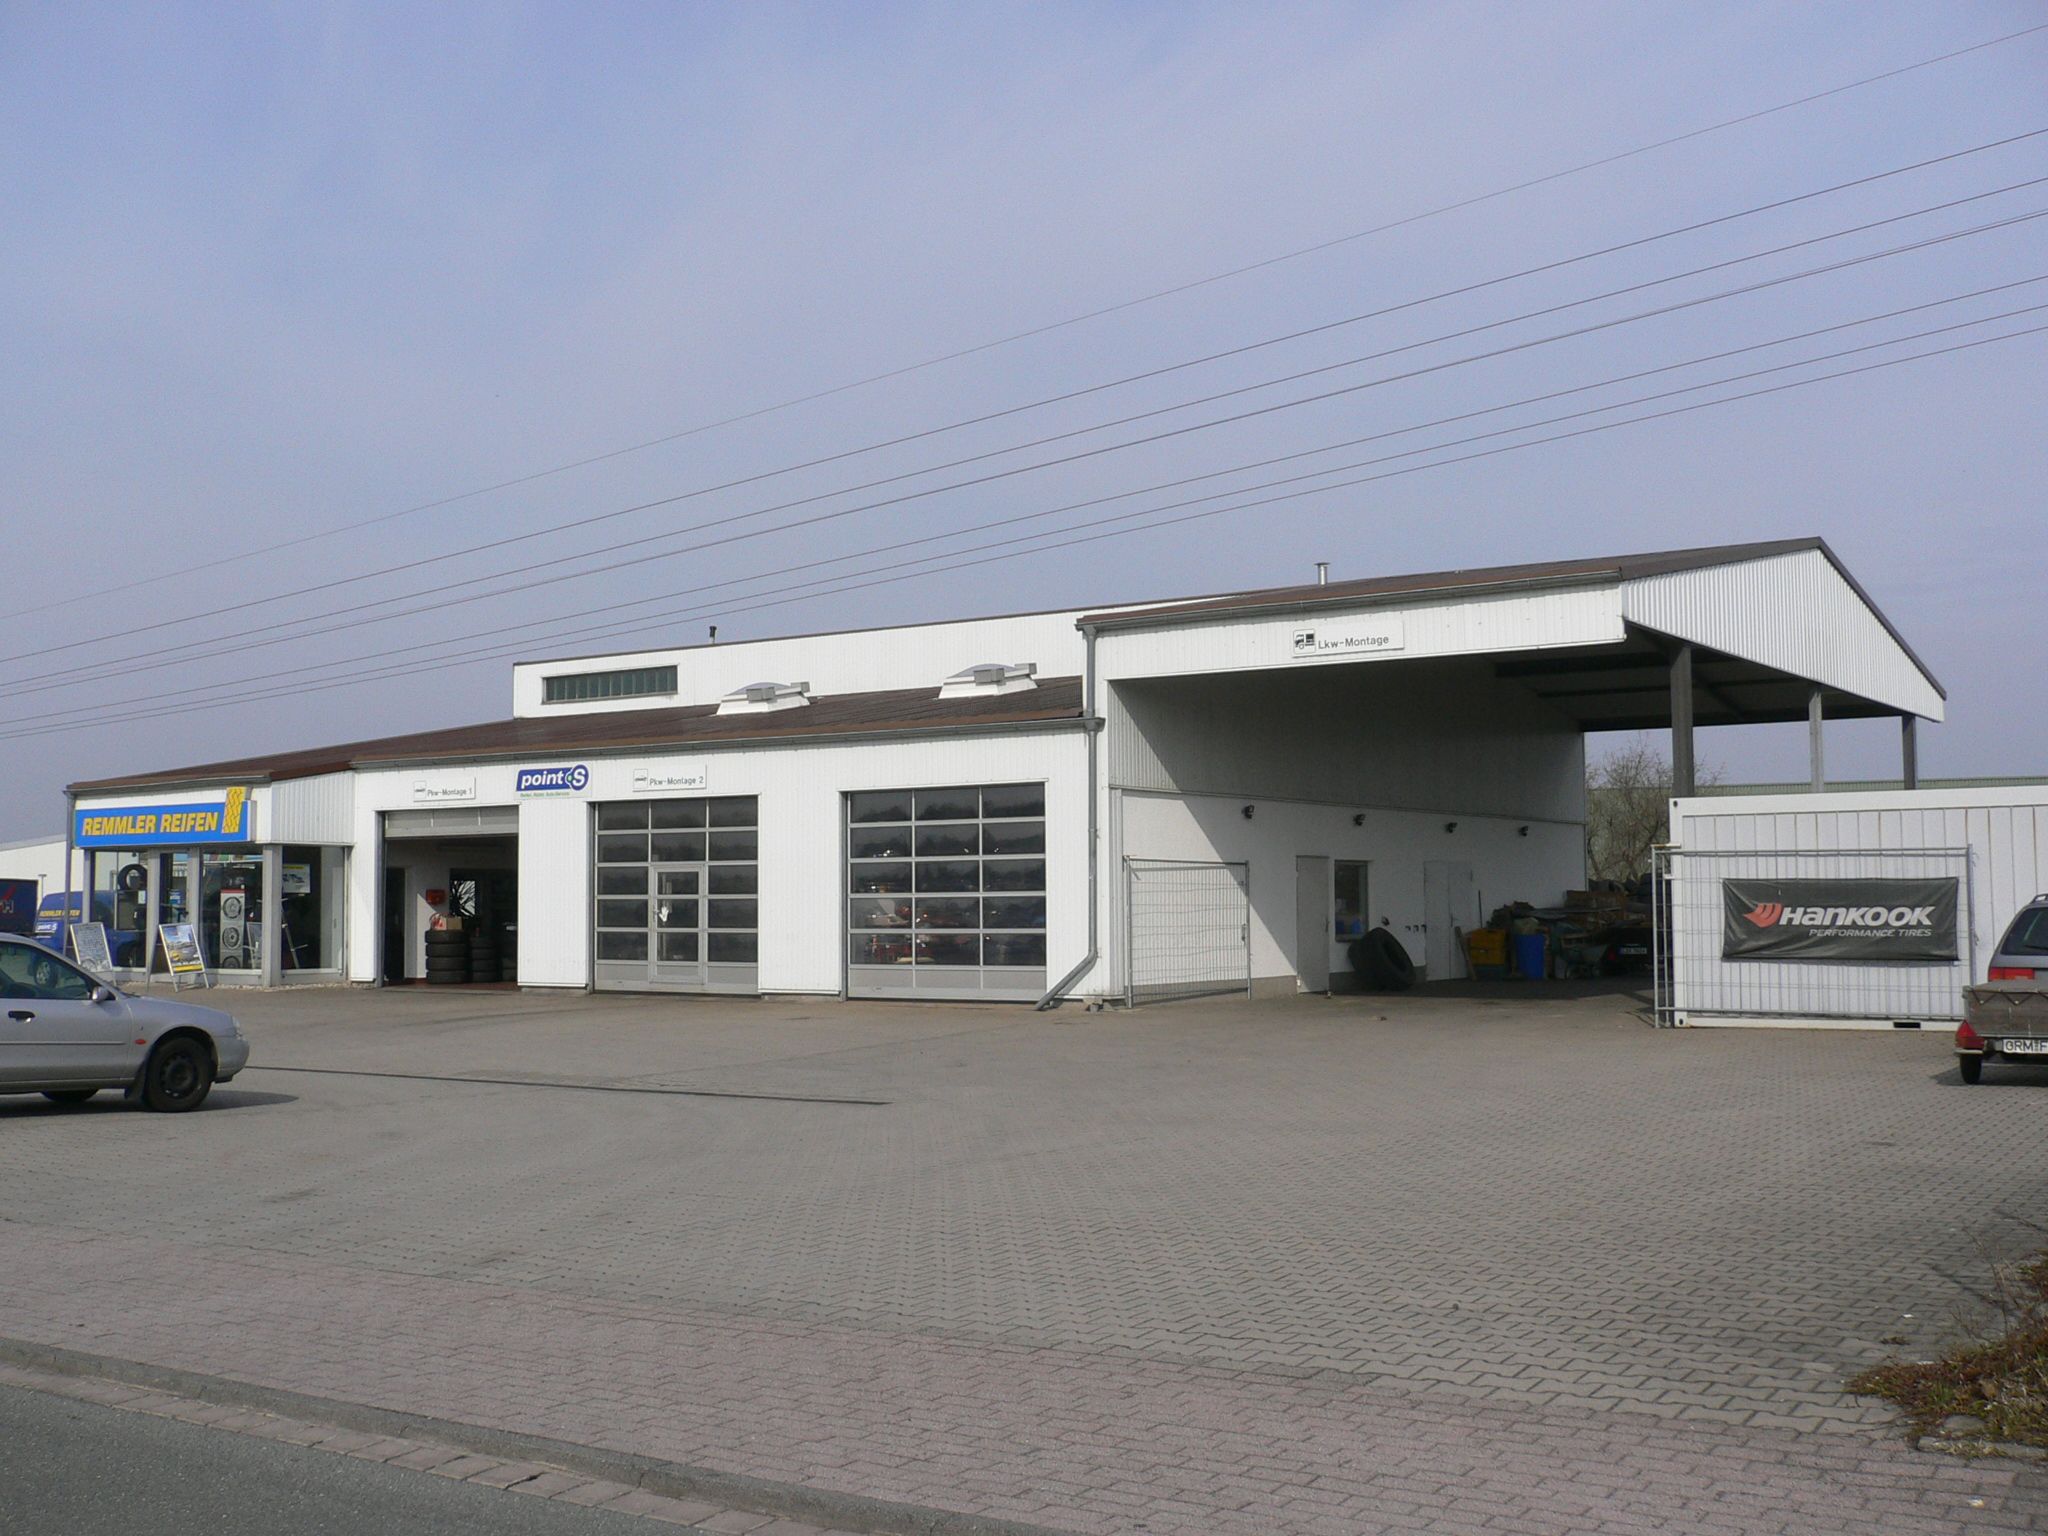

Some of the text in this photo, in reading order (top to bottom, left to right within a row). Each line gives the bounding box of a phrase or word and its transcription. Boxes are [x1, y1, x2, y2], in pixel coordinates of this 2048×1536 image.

[1318, 636, 1389, 650] Lkw-Montage
[521, 768, 586, 789] point S
[698, 776, 704, 784] 2
[82, 812, 219, 836] REMMLER REIFEN
[1808, 929, 1932, 937] PERFORMANCE TIRES
[2005, 1040, 2034, 1052] GRM
